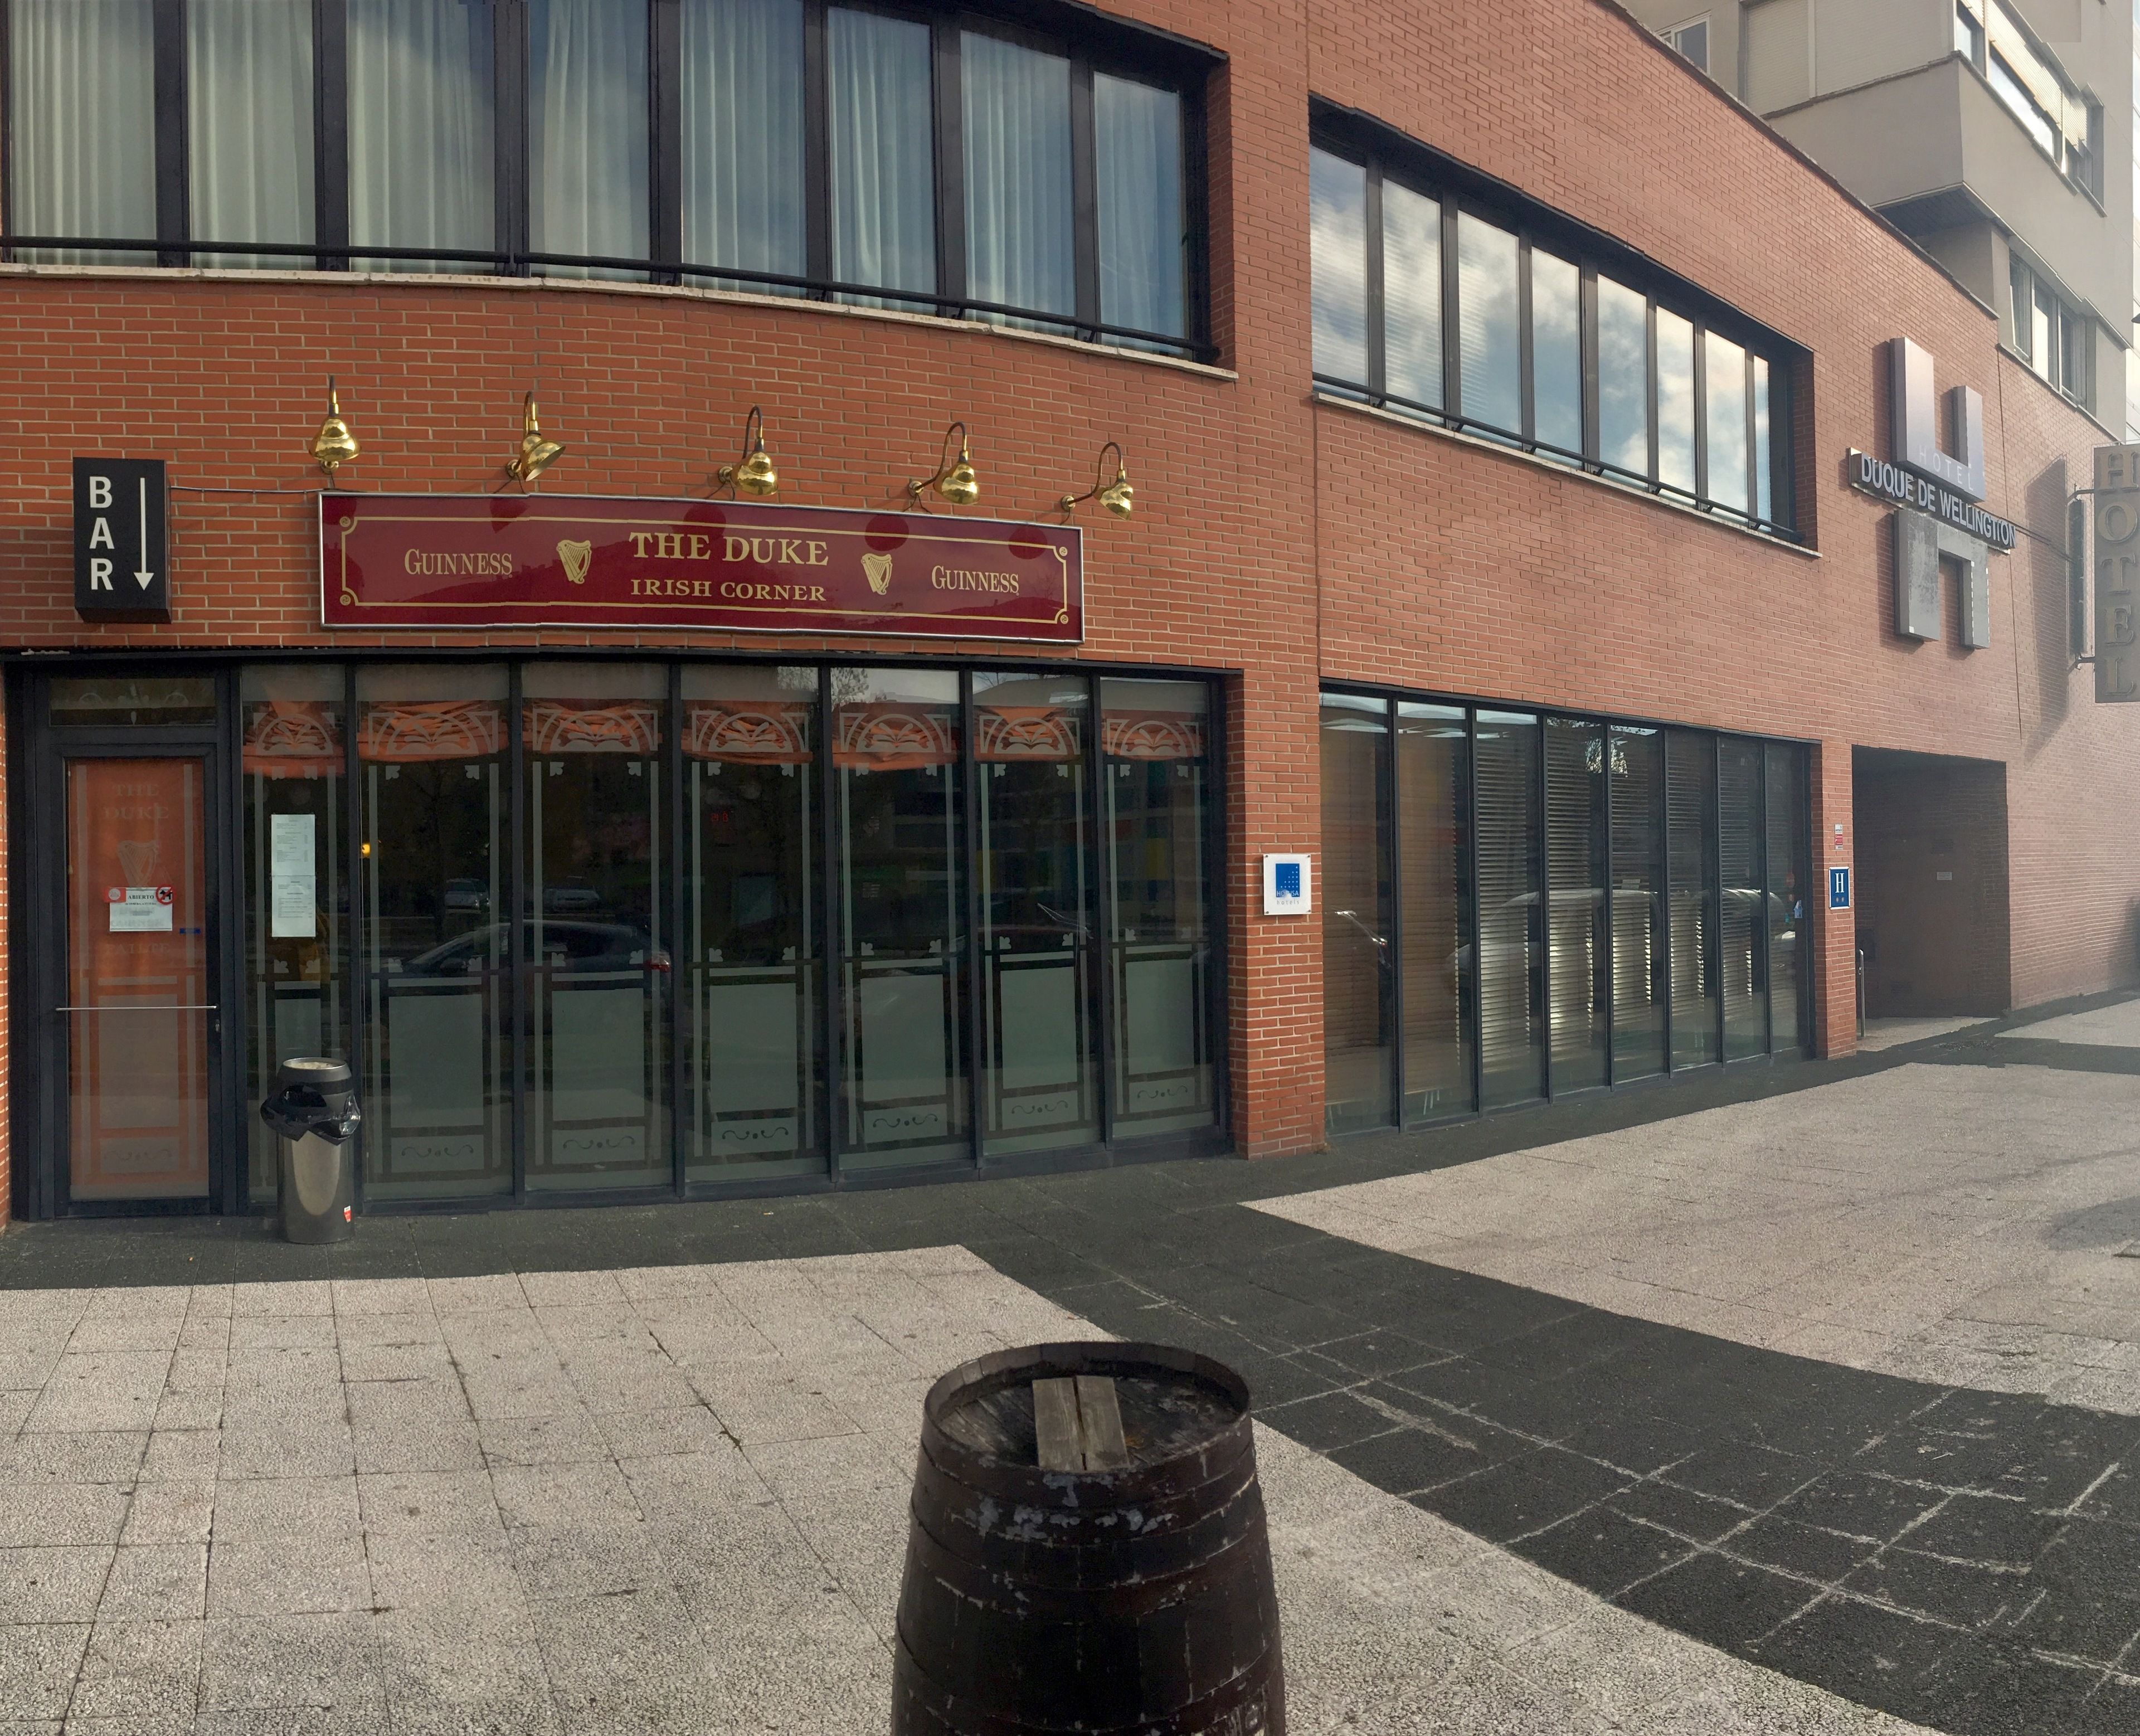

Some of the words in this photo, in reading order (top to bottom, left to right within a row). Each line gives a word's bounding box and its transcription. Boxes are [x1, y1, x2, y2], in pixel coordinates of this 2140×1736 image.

[1861, 453, 1914, 502] DUQUE
[1918, 478, 1936, 512] DE
[1919, 445, 1973, 492] HOTEL
[89, 476, 115, 590] BAR
[629, 532, 711, 560] THE
[722, 536, 829, 566] DUKE
[404, 548, 512, 576] GUINNESS
[2097, 450, 2139, 695] HOTEL
[630, 579, 712, 597] IRISH
[720, 582, 826, 601] CORNER
[932, 565, 1019, 594] GUINNESS
[1835, 873, 1845, 893] H
